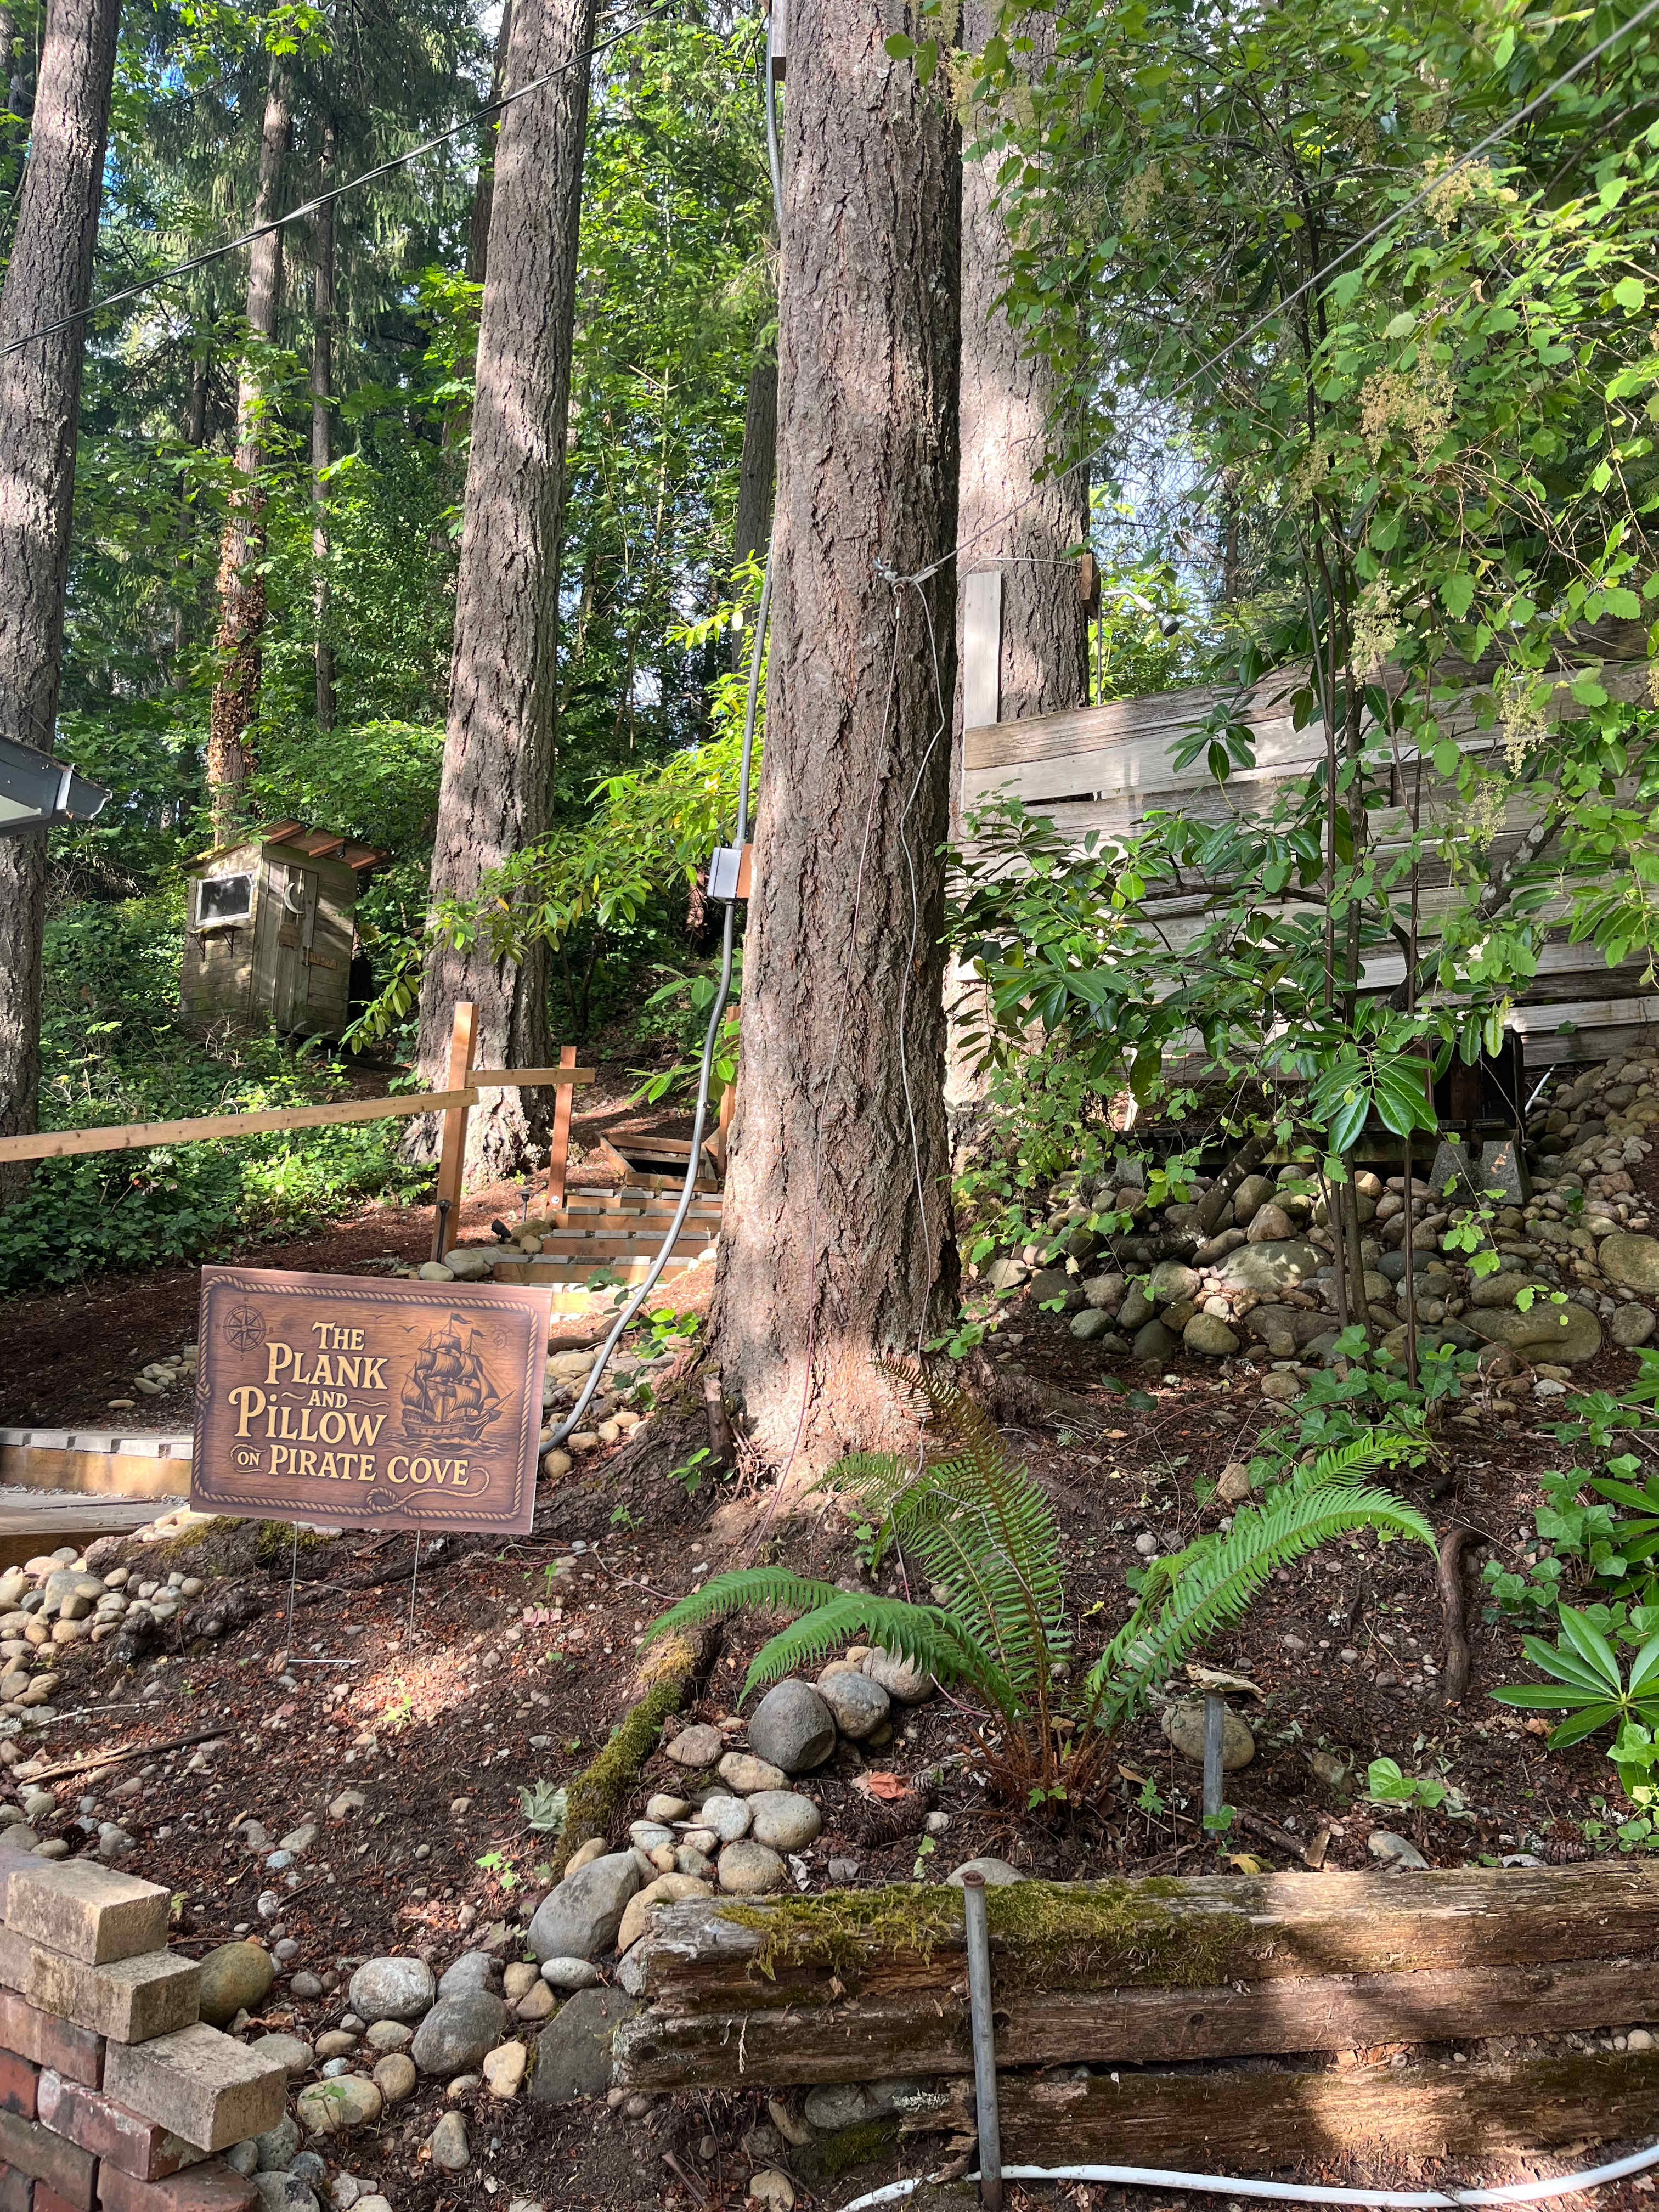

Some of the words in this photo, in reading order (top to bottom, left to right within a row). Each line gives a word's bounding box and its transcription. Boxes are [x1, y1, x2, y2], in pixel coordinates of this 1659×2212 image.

[312, 1321, 365, 1350] THE
[264, 1342, 388, 1389] PLANK
[307, 1390, 348, 1408] AND
[237, 1452, 261, 1466] ON
[268, 1444, 376, 1481] PIRATE
[387, 1455, 469, 1485] COVE
